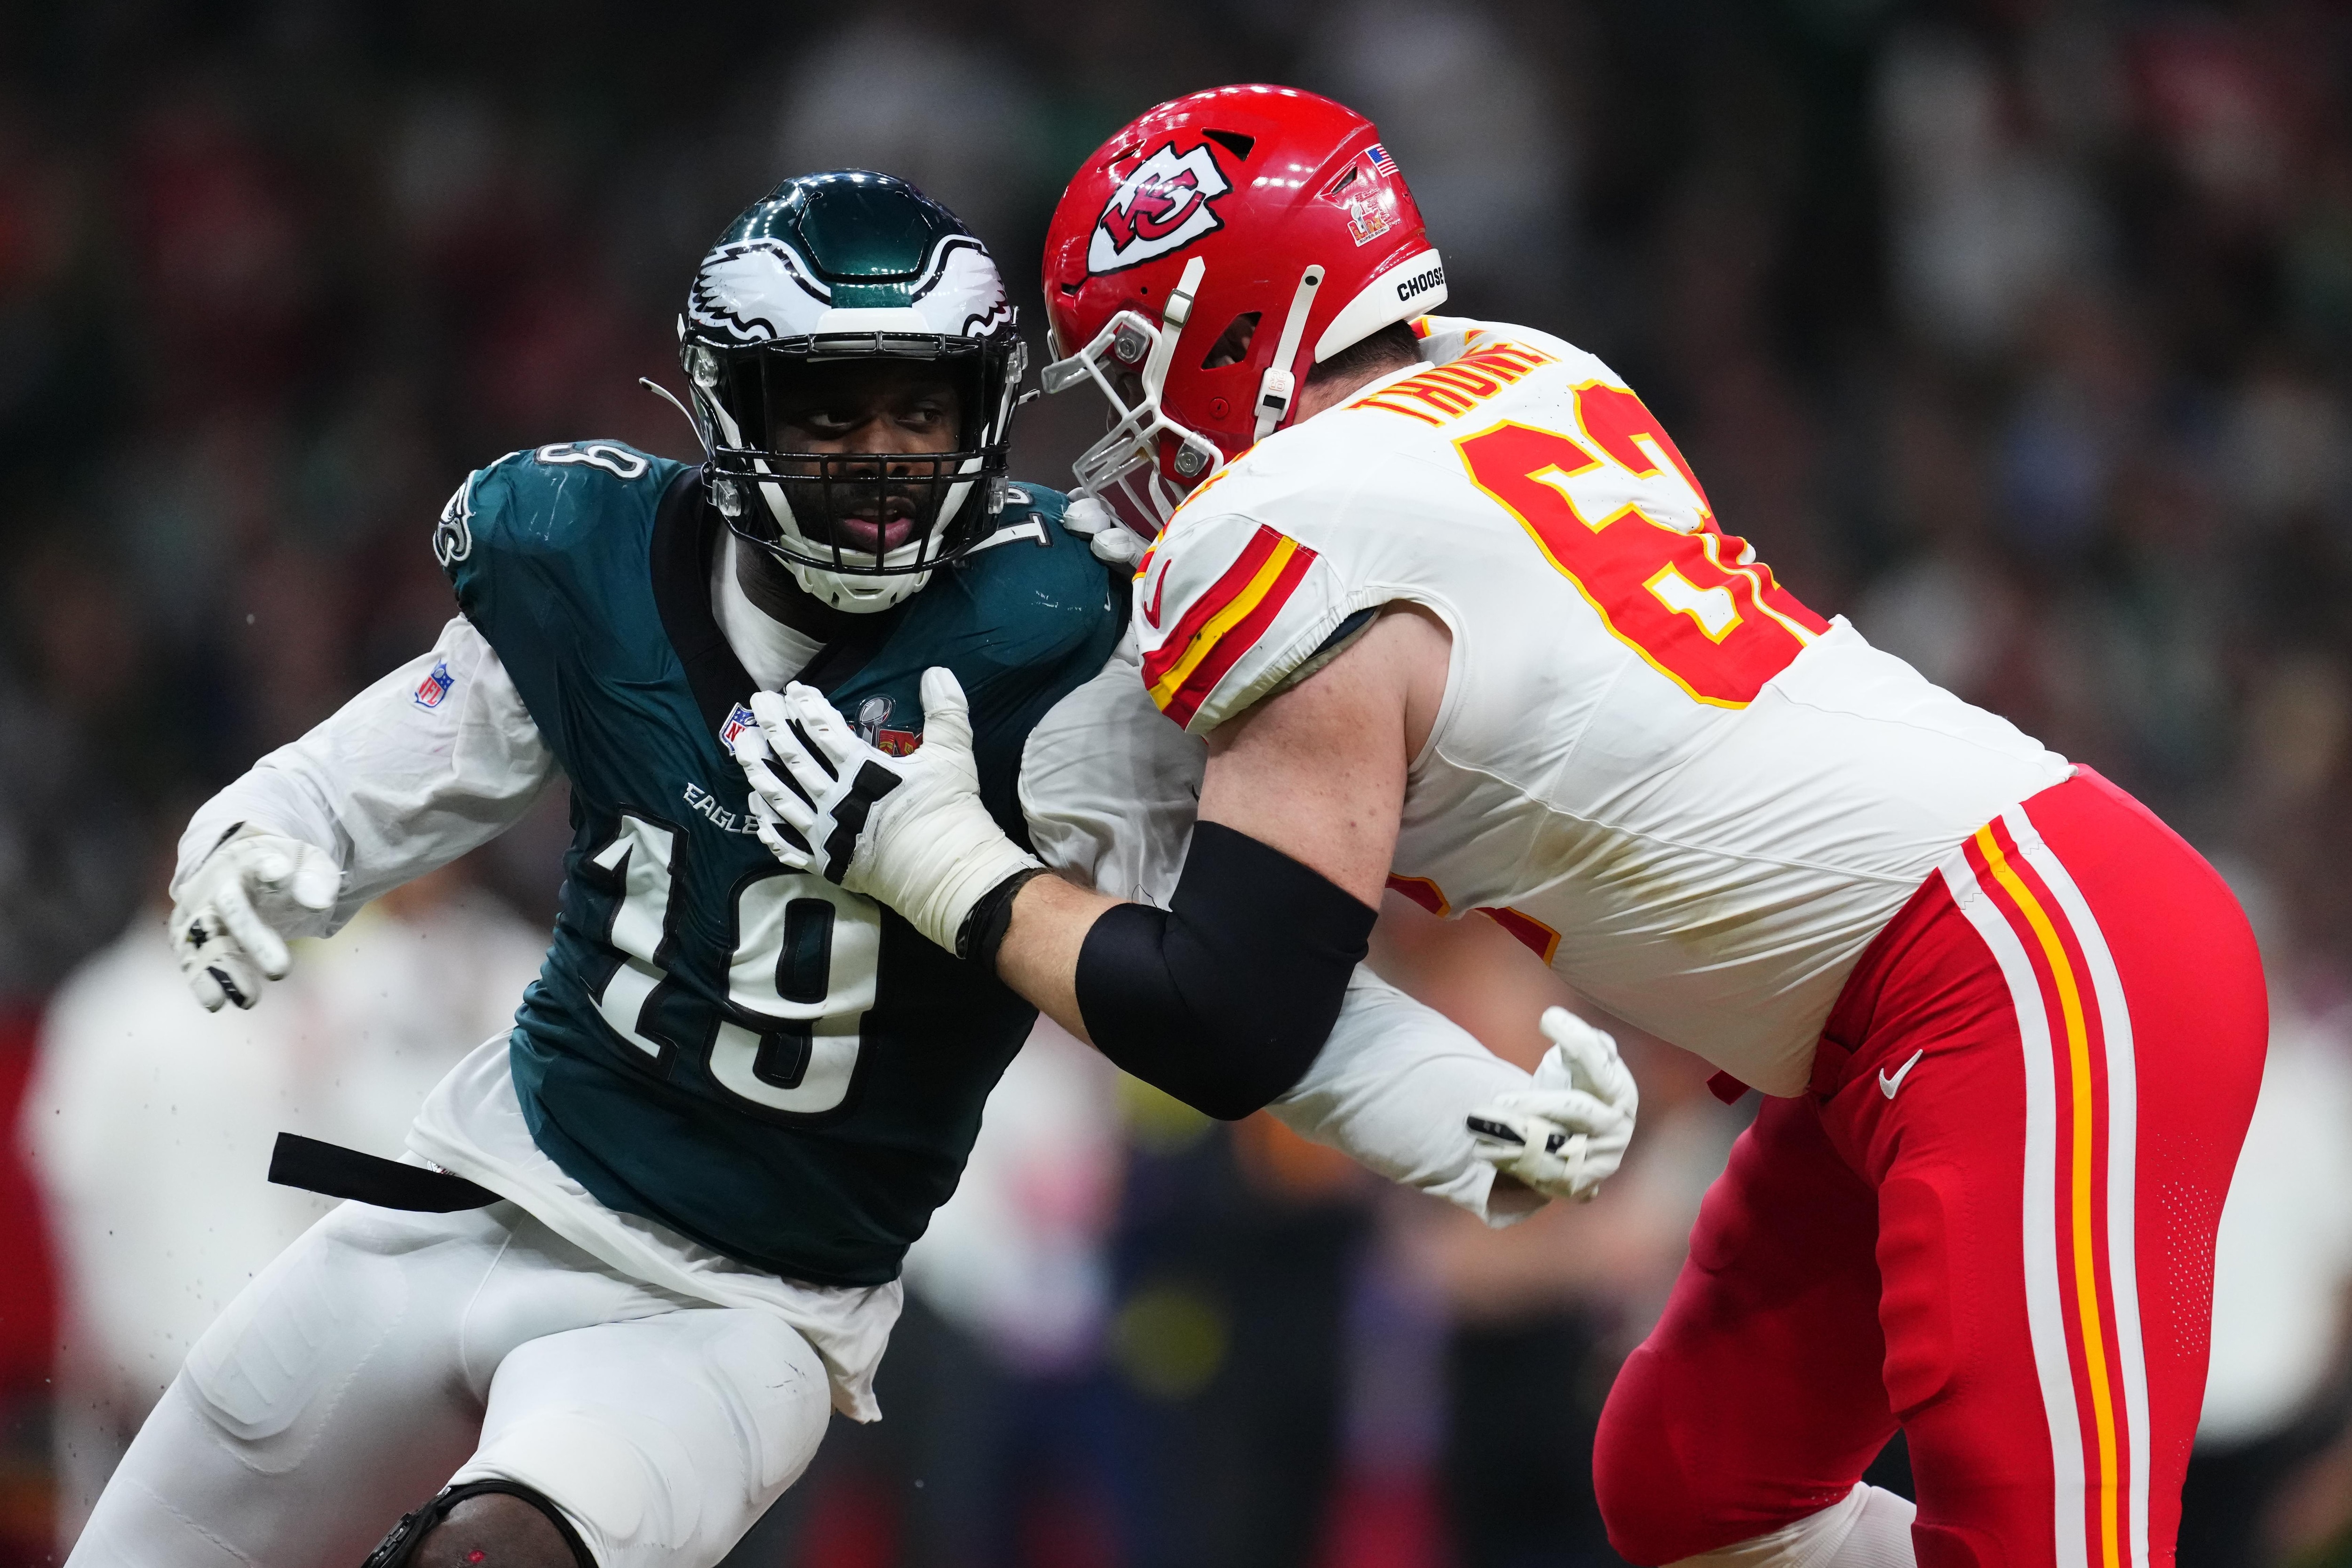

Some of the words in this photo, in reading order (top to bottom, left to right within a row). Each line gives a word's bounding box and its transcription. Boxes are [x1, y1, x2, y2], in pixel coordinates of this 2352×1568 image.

[1100, 167, 1206, 256] KC
[1359, 234, 1375, 244] SUPER
[1397, 267, 1444, 302] CHOOSE
[1450, 378, 1833, 710] 62
[683, 782, 760, 835] EAGLE
[587, 813, 883, 1115] 19
